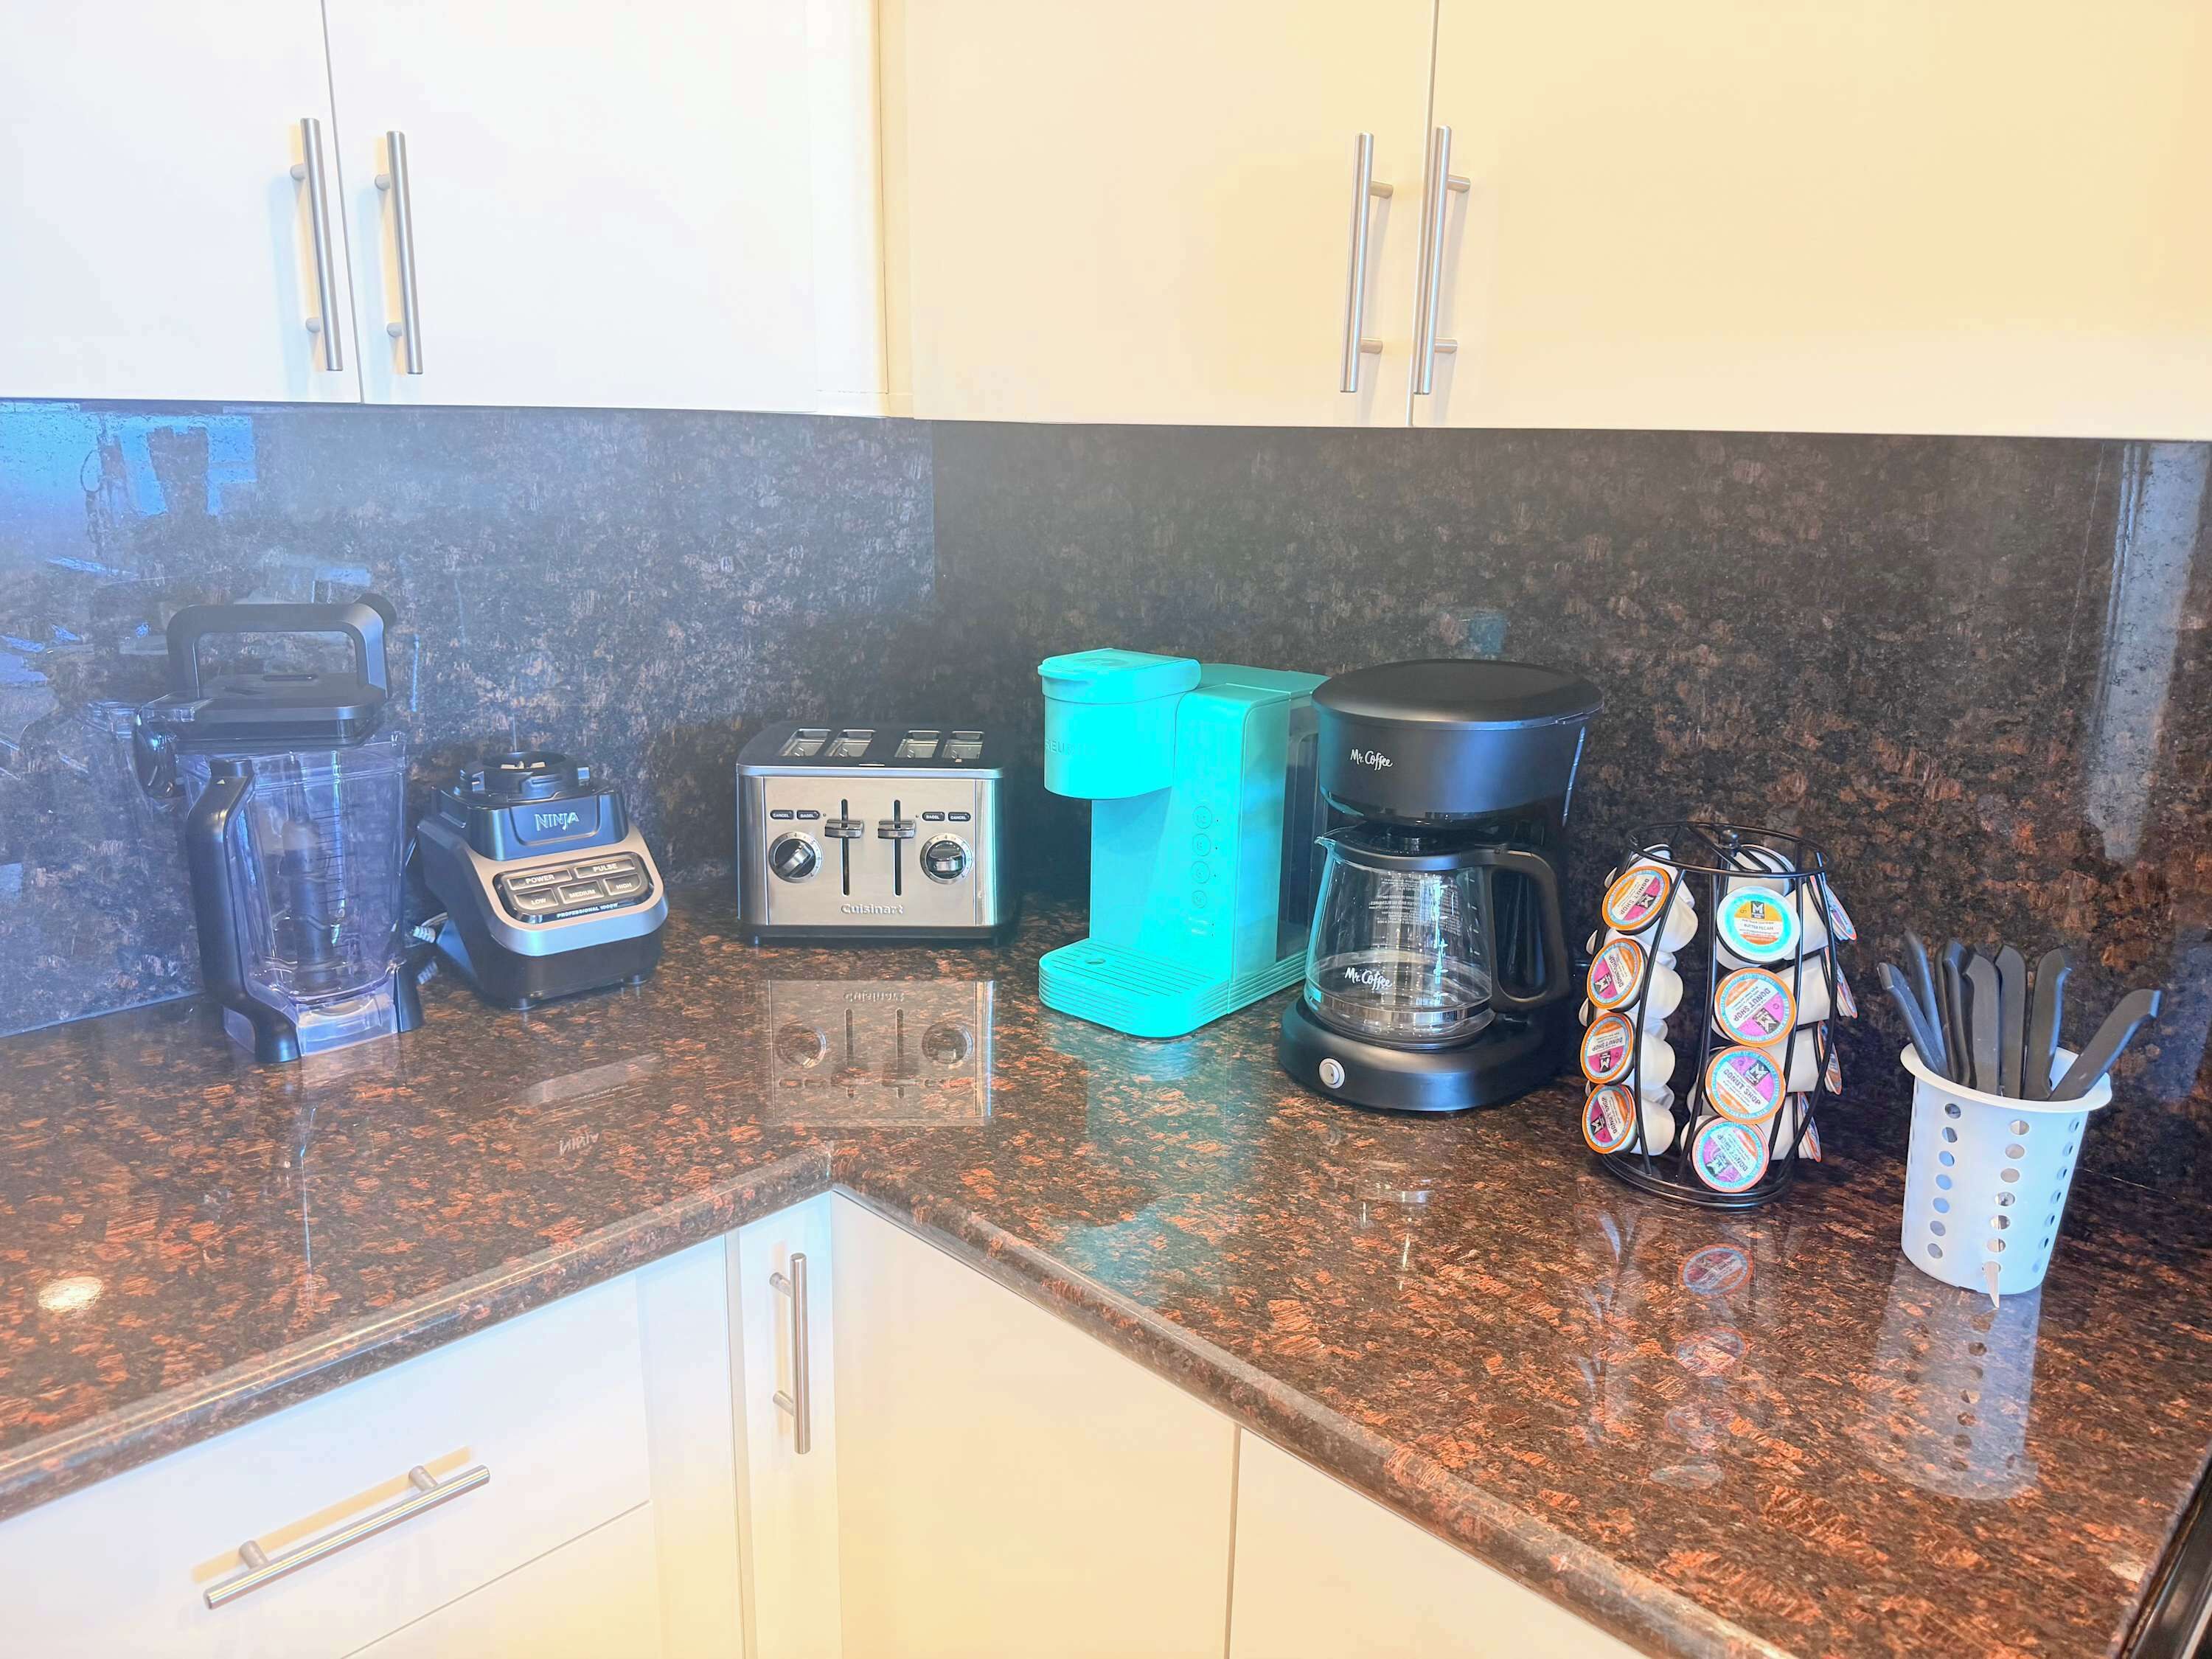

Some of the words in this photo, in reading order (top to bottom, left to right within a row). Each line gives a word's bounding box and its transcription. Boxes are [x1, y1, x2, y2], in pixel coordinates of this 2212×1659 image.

[1350, 748, 1364, 765] Mr.
[1364, 750, 1394, 771] Coffee
[534, 812, 580, 832] NINJA
[592, 863, 618, 872] PULSE
[525, 874, 555, 884] POWER
[616, 882, 632, 890] HIGH
[568, 888, 596, 899] MEDIUM
[1634, 878, 1649, 899] DONUT
[530, 897, 546, 905] LOW
[1621, 899, 1635, 915] SHOP
[556, 905, 599, 918] PROFESSIONAL
[841, 903, 903, 914] Cuisinart
[1344, 967, 1361, 984] Mr.
[1361, 970, 1393, 991] Coffee
[1750, 987, 1771, 1009] DONUT
[1733, 1006, 1751, 1021] SHOP
[1592, 1043, 1606, 1051] SHOP
[1605, 1037, 1623, 1046] DONUT
[1722, 1068, 1745, 1089] DONUT
[1744, 1088, 1761, 1105] SHOP
[1607, 1113, 1618, 1134] DONUT
